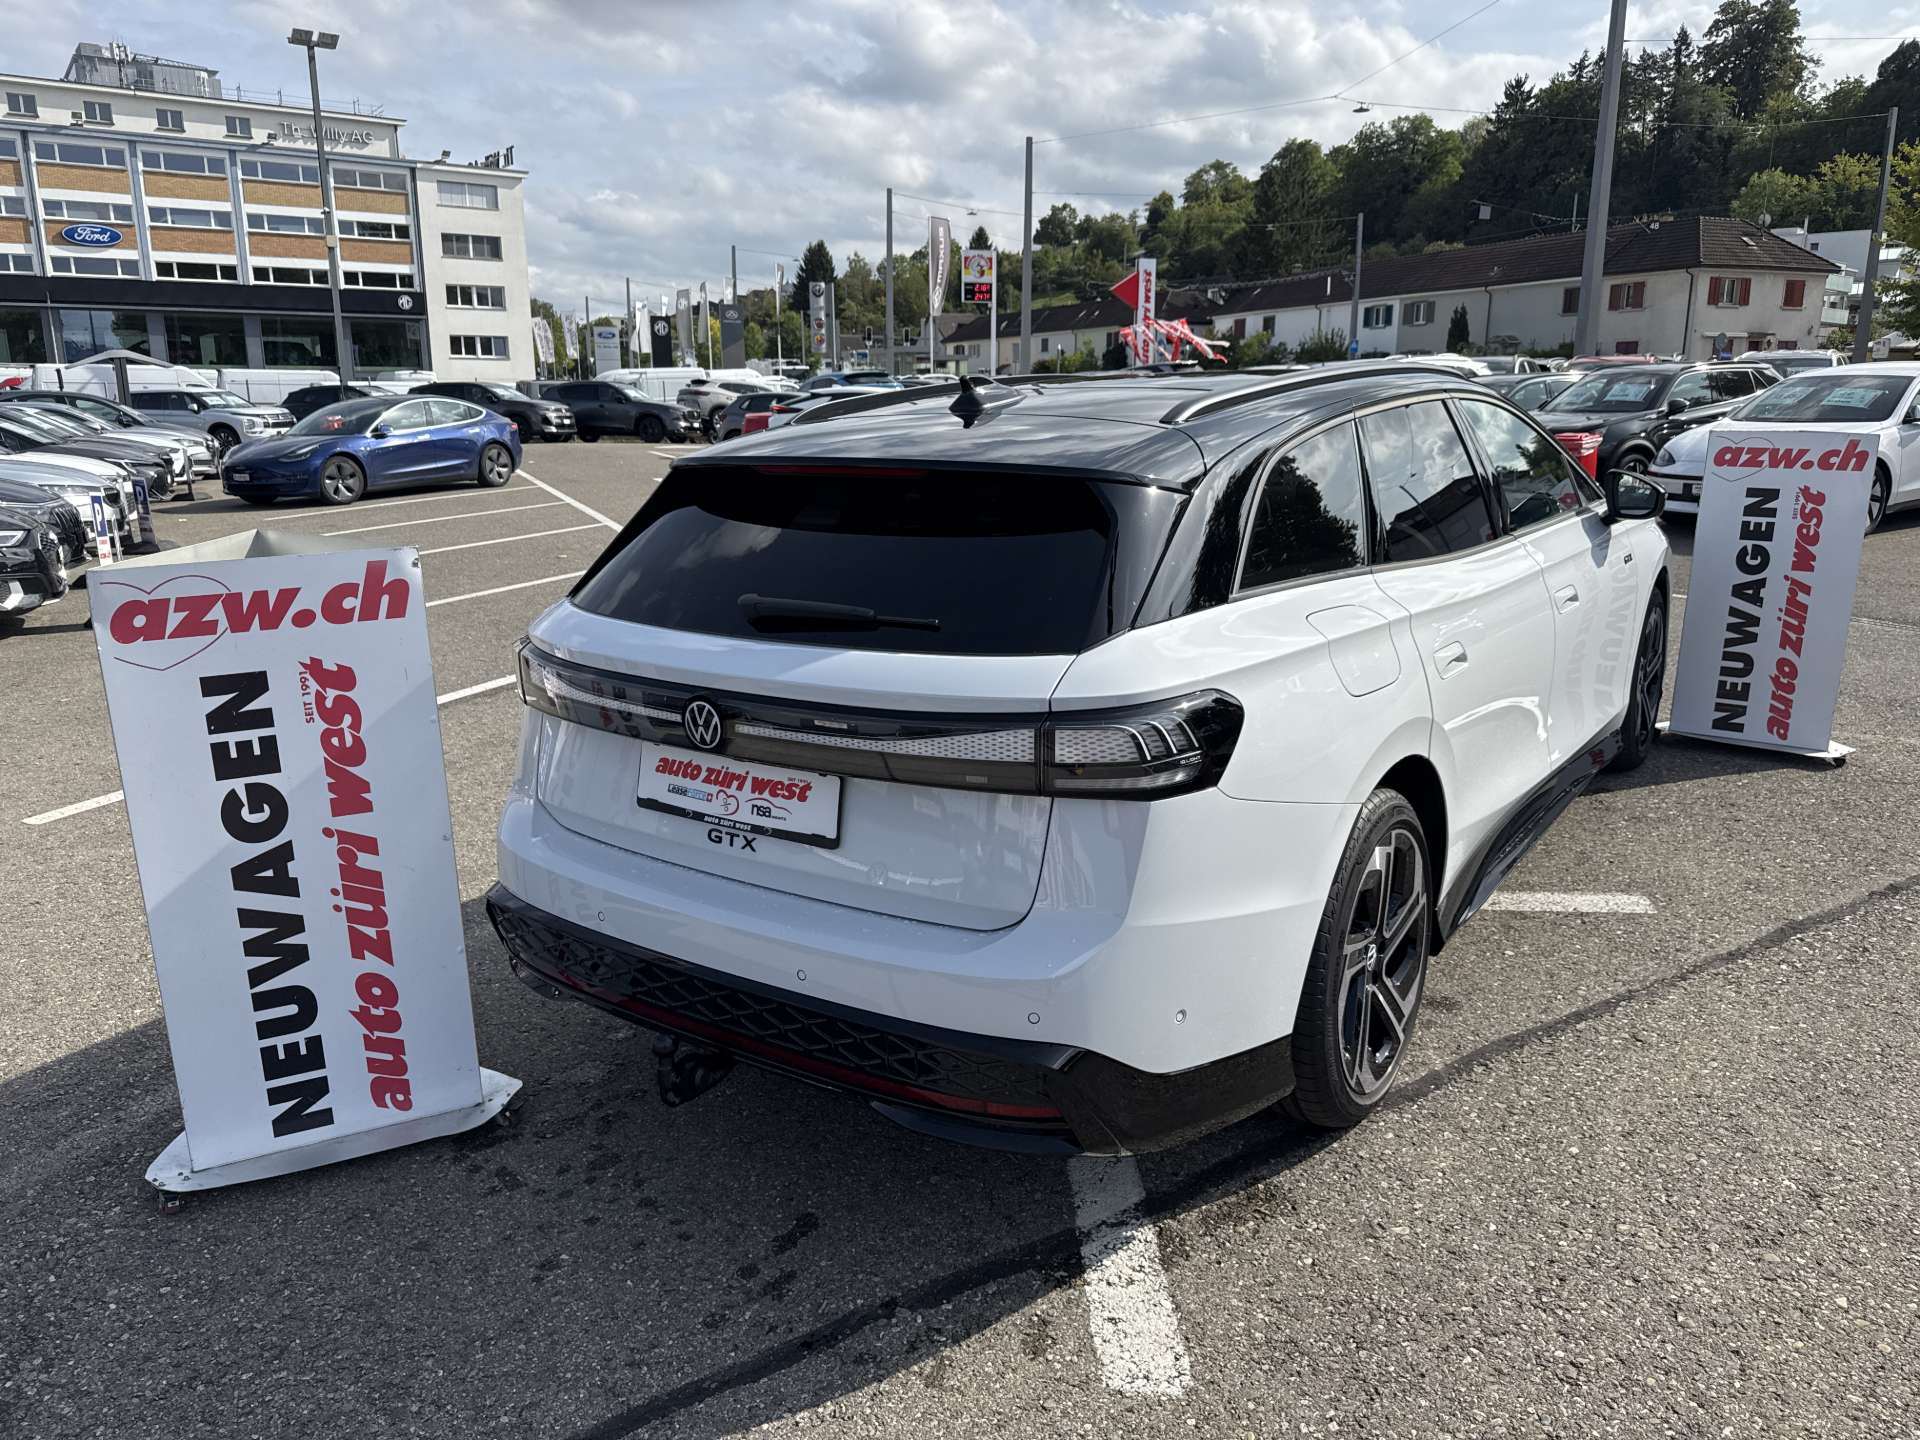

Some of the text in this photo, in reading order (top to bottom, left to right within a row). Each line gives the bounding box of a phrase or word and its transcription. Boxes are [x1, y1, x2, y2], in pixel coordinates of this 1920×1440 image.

[351, 128, 375, 144] AG
[74, 226, 111, 242] Ford
[398, 295, 413, 310] MG
[653, 320, 669, 337] MG
[1713, 439, 1870, 472] azw.ch
[93, 502, 103, 532] P
[109, 559, 410, 645] azw.ch
[1711, 487, 1781, 733] NEUWAGEN
[1766, 485, 1826, 741] auto züri west
[298, 671, 315, 724] SEIT 1991
[655, 755, 813, 802] auto züri west
[751, 803, 772, 819] nsa
[707, 827, 758, 853] GTX
[298, 655, 411, 1112] auto züri west
[198, 670, 335, 1138] NEUWAGEN
